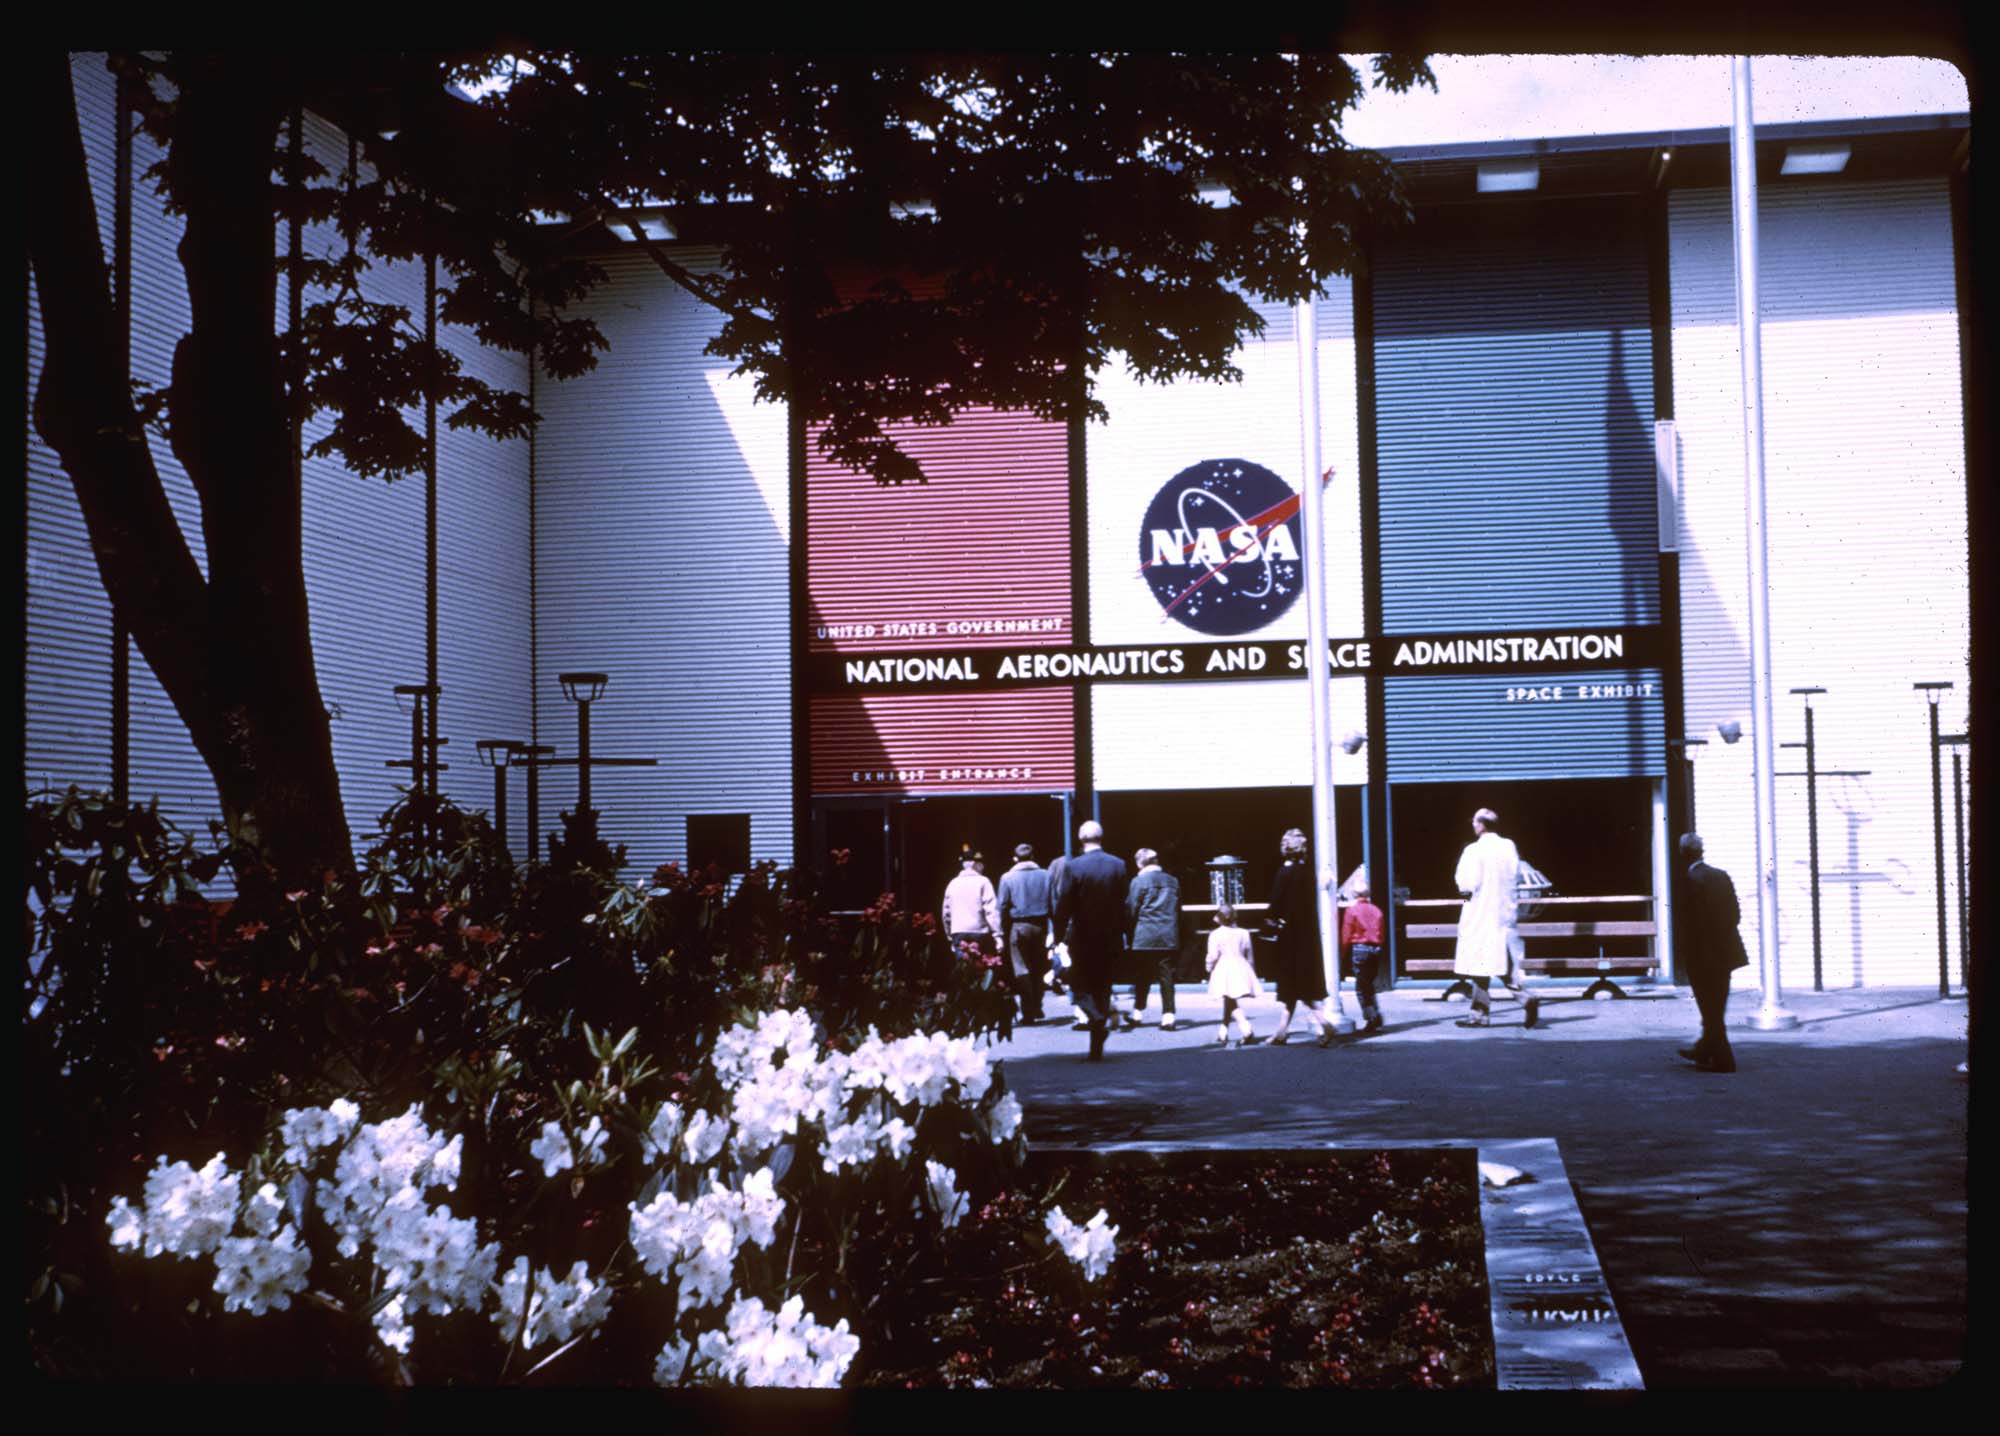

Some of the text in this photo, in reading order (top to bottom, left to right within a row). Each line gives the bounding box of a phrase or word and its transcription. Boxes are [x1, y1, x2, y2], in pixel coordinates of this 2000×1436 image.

[1150, 524, 1300, 565] NASA
[817, 618, 1064, 639] UNITED STATES GOVERNMENT
[845, 656, 979, 683] NATIONAL
[997, 649, 1185, 680] AERONAUTICS
[1205, 647, 1267, 672] AND
[1393, 634, 1624, 667] ADMINISTRATION
[1506, 684, 1653, 701] SPACE EXHIBIT
[852, 767, 1032, 782] EXHIBIT ENTRANCE
